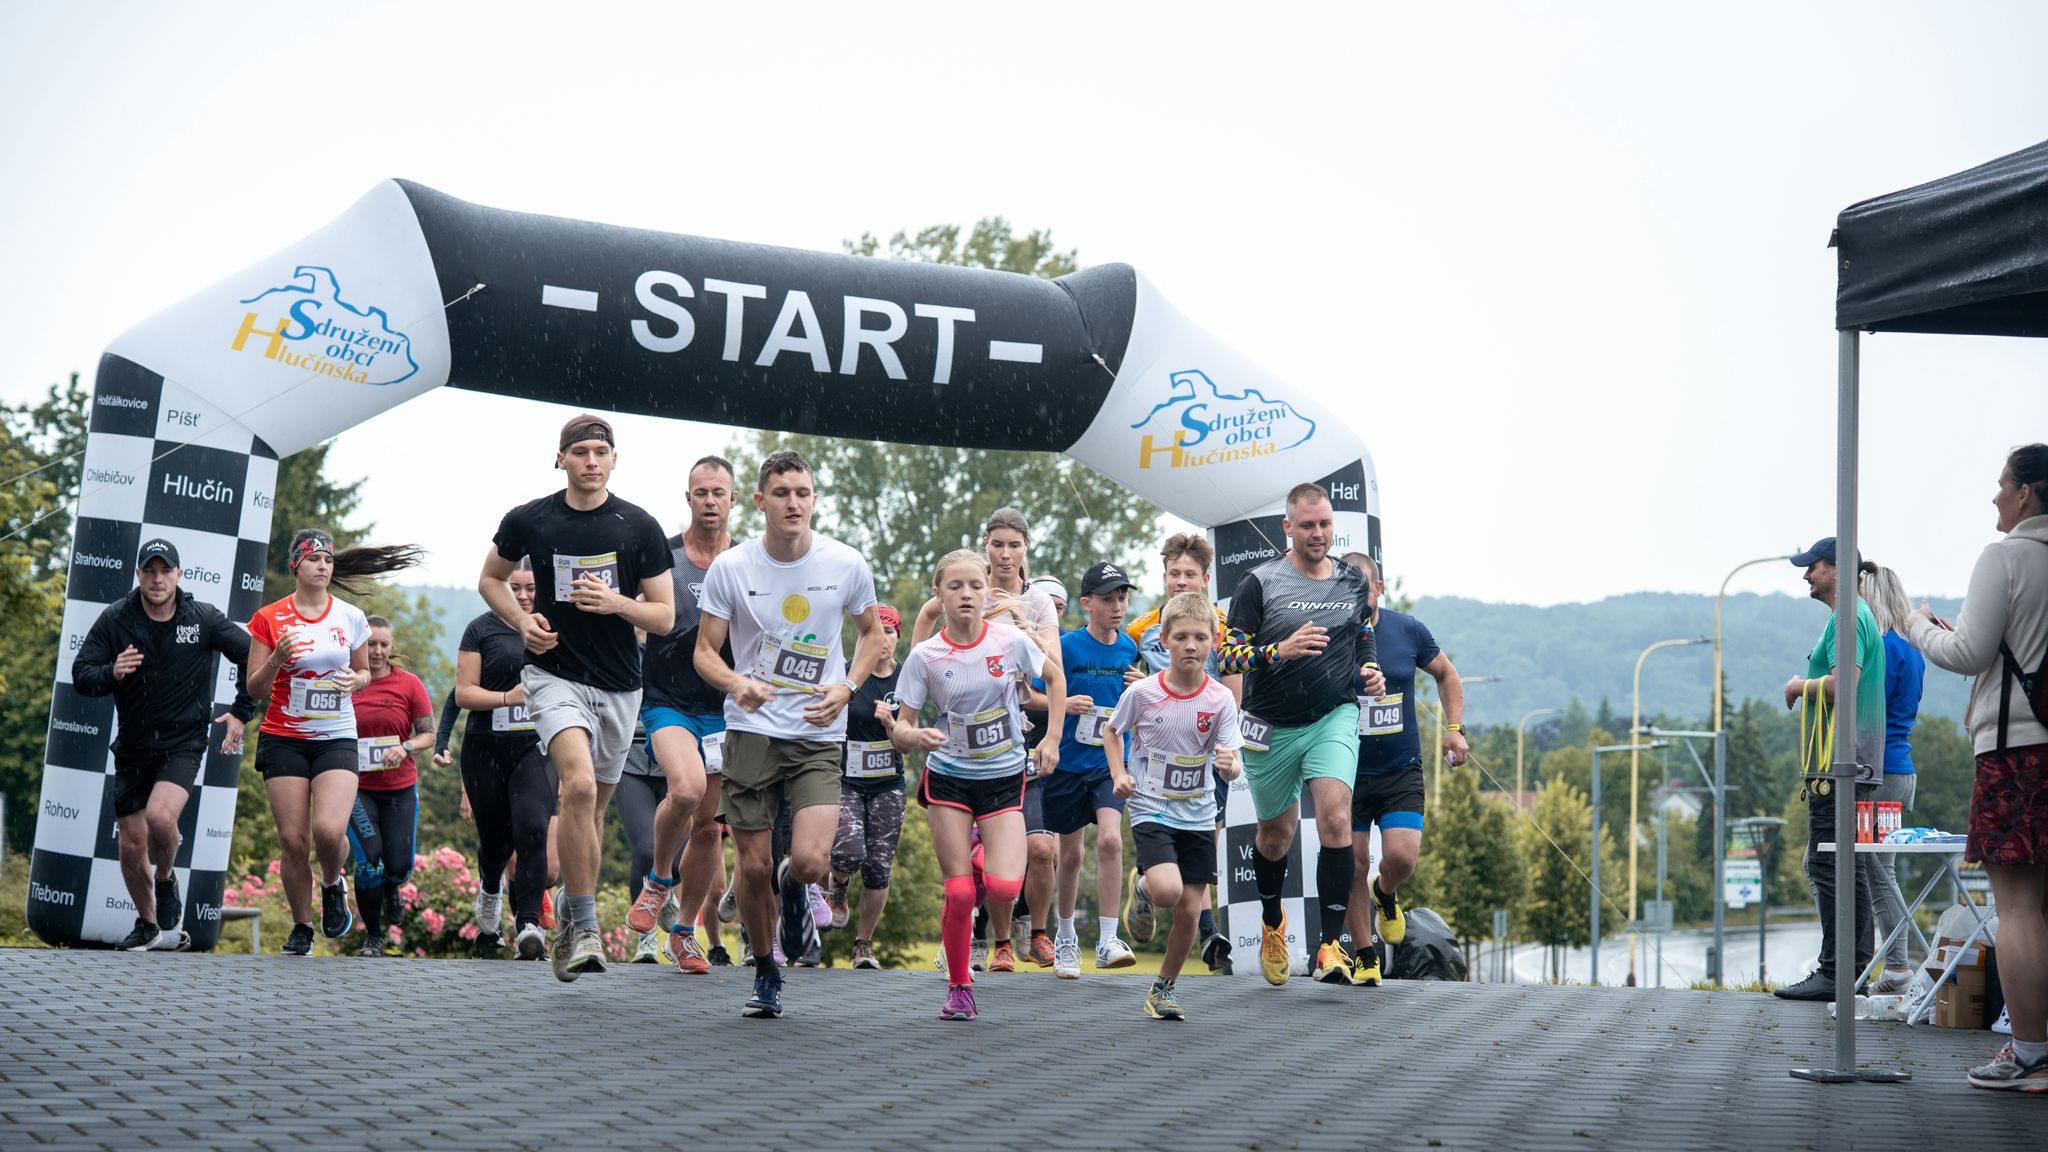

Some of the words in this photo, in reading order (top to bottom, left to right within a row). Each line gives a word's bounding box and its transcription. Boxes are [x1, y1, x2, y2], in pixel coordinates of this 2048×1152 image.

[280, 298, 408, 355] Sdružení
[631, 270, 976, 385] START
[230, 312, 368, 384] Hlučínska
[325, 343, 380, 367] obcí
[166, 409, 201, 427] Píšť
[1178, 402, 1287, 447] Sdružení
[1225, 421, 1272, 446] obcí
[1138, 429, 1277, 469] Hlučínska
[86, 468, 136, 485] Chlebičov
[163, 473, 234, 504] Hlučín
[1330, 482, 1360, 501] Hať
[74, 551, 123, 570] Strahovice
[1221, 548, 1275, 565] Ludgeřovice
[183, 566, 221, 584] eřice
[1101, 572, 1122, 580] adidas
[1287, 601, 1354, 611] DYNAFIT
[781, 656, 820, 681] 045
[310, 693, 337, 709] 056
[513, 707, 530, 721] 04
[1374, 707, 1400, 726] 049
[53, 718, 99, 735] Dobroslavice
[975, 720, 1005, 746] 051
[1241, 722, 1268, 742] 047
[867, 752, 892, 769] 055
[1170, 769, 1201, 788] 050
[44, 800, 80, 820] Rohov
[31, 881, 75, 906] Třebom
[106, 897, 137, 911] Bohu
